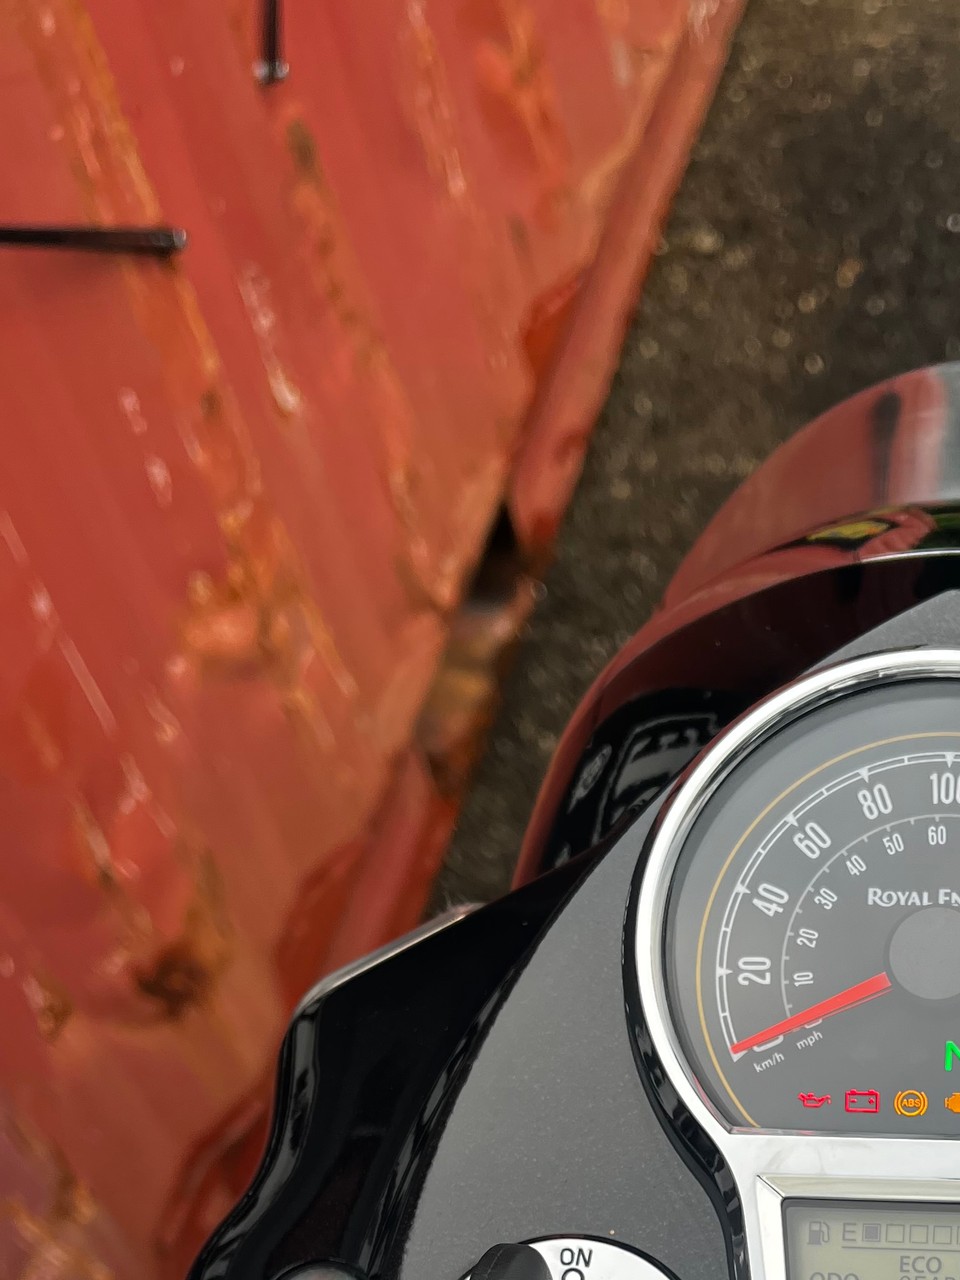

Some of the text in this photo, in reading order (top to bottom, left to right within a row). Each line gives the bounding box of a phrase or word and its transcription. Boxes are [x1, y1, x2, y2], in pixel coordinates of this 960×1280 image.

[857, 783, 893, 820] 80
[792, 822, 832, 859] 60
[882, 833, 905, 856] 50
[928, 825, 946, 845] 60
[845, 854, 867, 876] 40
[752, 883, 789, 917] 40
[814, 887, 838, 910] 30
[867, 887, 933, 908] ROYAL
[796, 927, 819, 948] 20
[737, 956, 771, 985] 20
[793, 971, 814, 987] 10
[796, 1030, 823, 1050] mph
[753, 1052, 785, 1073] km/h
[902, 1098, 921, 1108] ABS
[842, 1222, 857, 1242] E
[559, 1247, 592, 1268] ON
[900, 1256, 942, 1273] ECO
